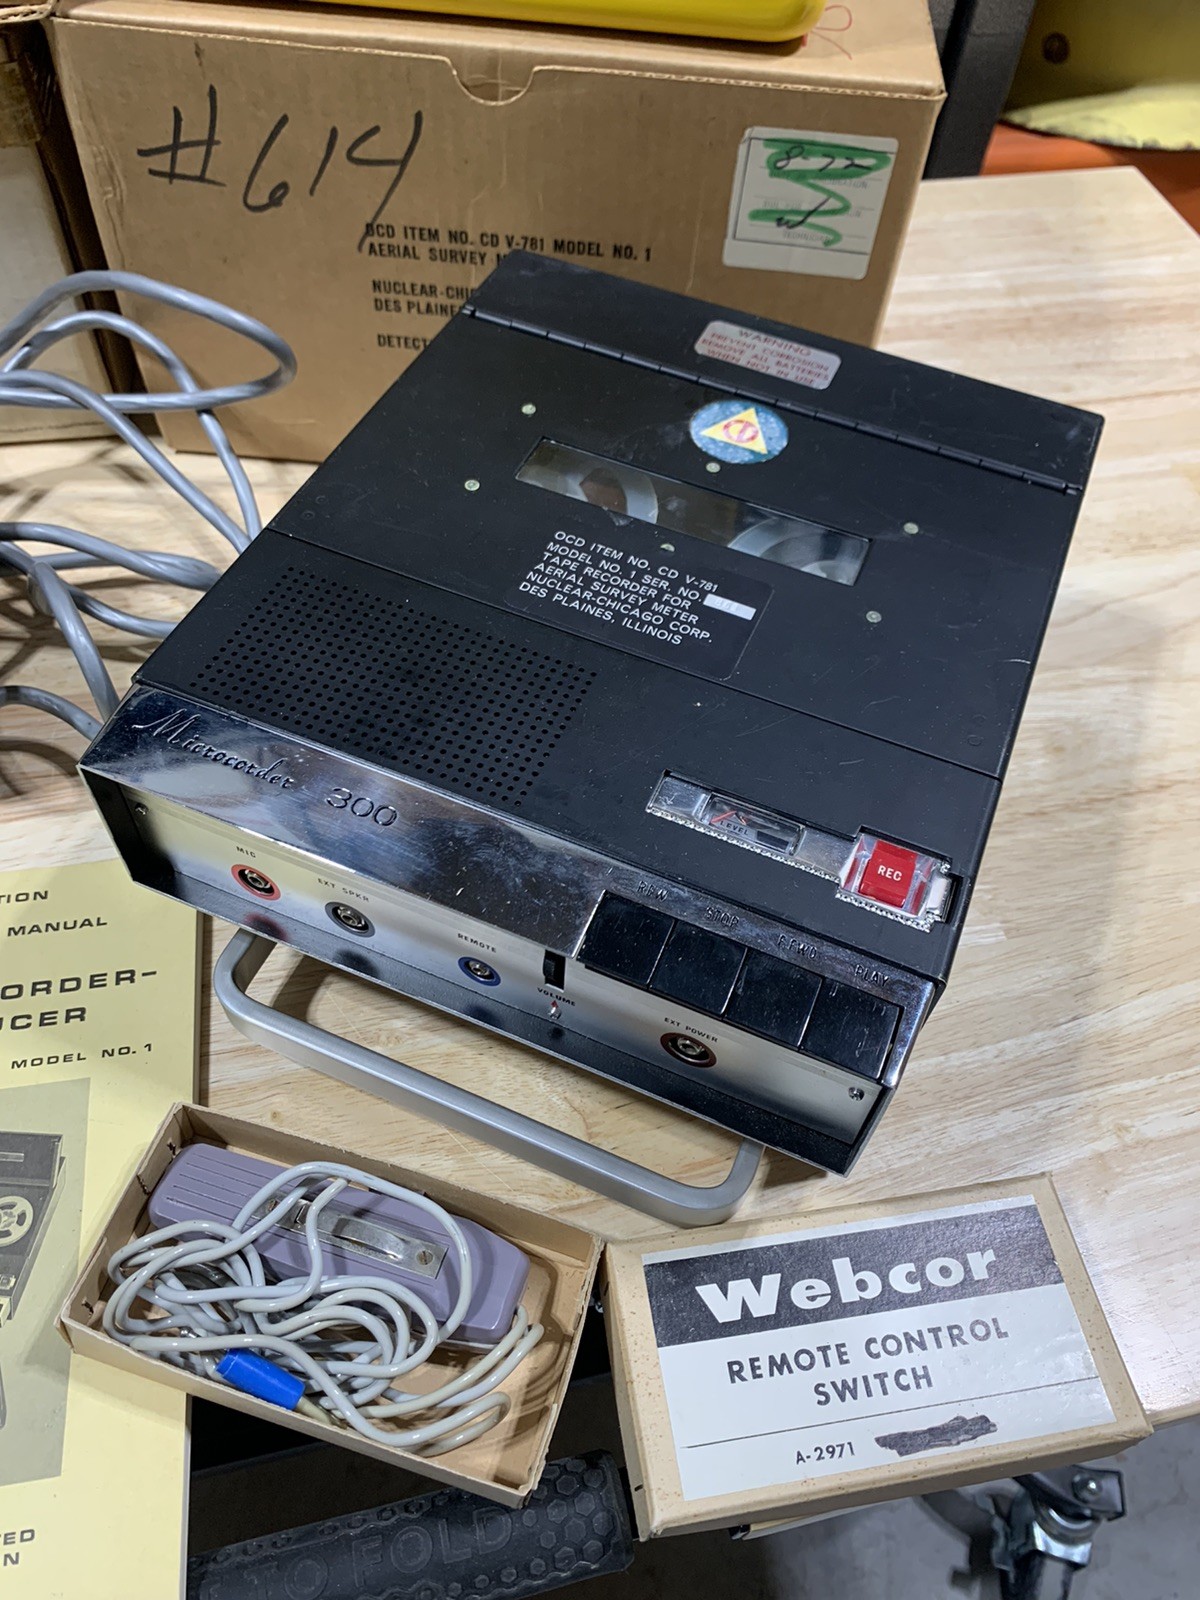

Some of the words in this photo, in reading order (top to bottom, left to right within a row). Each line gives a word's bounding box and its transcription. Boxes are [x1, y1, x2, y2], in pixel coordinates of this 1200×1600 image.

[368, 241, 421, 260] AERIAL
[429, 246, 487, 266] SURVEY
[403, 225, 440, 243] ITEM
[448, 229, 474, 246] NO.
[480, 232, 499, 248] CD
[505, 234, 545, 252] V-781
[553, 239, 605, 258] MODEL
[612, 244, 639, 261] NO.
[644, 248, 652, 263] 1
[374, 296, 403, 313] DES
[738, 329, 812, 357] WARNING
[746, 360, 770, 372] NOT
[546, 541, 593, 565] MODEL
[599, 559, 622, 575] NO.
[629, 570, 636, 578] 1
[641, 575, 671, 592] SER.
[677, 586, 702, 602] NO.
[554, 530, 586, 547] OCD
[590, 543, 624, 561] ITEM
[627, 555, 651, 571] NO.
[657, 565, 680, 579] CD
[685, 574, 719, 592] V-781
[533, 562, 584, 586] AERIAL
[590, 581, 648, 609] SURVEY
[651, 602, 700, 625] METER
[542, 552, 578, 572] TAPE
[584, 566, 658, 597] RECORDER
[661, 592, 692, 610] FOR
[518, 582, 548, 599] DES
[552, 594, 616, 624] PLAINES,
[621, 617, 683, 645] ILLINOIS
[526, 571, 664, 625] NUCLEAR-CHICAGO
[669, 621, 713, 643] CORP.
[131, 708, 295, 790] Microcorder
[325, 787, 398, 827] 300
[719, 820, 750, 836] LEVEL
[236, 846, 256, 858] MIC
[317, 878, 336, 889] EXT
[877, 864, 903, 882] REC
[7, 916, 108, 937] MANUAL
[705, 906, 740, 928] STOP
[457, 933, 497, 953] REMOTE
[854, 964, 890, 987] PLAY
[537, 987, 576, 1007] VOLUME
[0, 1006, 86, 1031] CER
[664, 1017, 681, 1027] EXT
[685, 1025, 718, 1042] POWER
[11, 1052, 87, 1070] MODEL
[101, 1045, 137, 1059] NO.
[143, 1043, 152, 1052] 1
[695, 1248, 998, 1324] Webcor
[727, 1341, 850, 1384] REMOTE
[865, 1316, 1010, 1361] CONTROL
[813, 1365, 934, 1406] SWITCH
[795, 1441, 856, 1465] A-2971
[352, 1507, 513, 1588] FOLD
